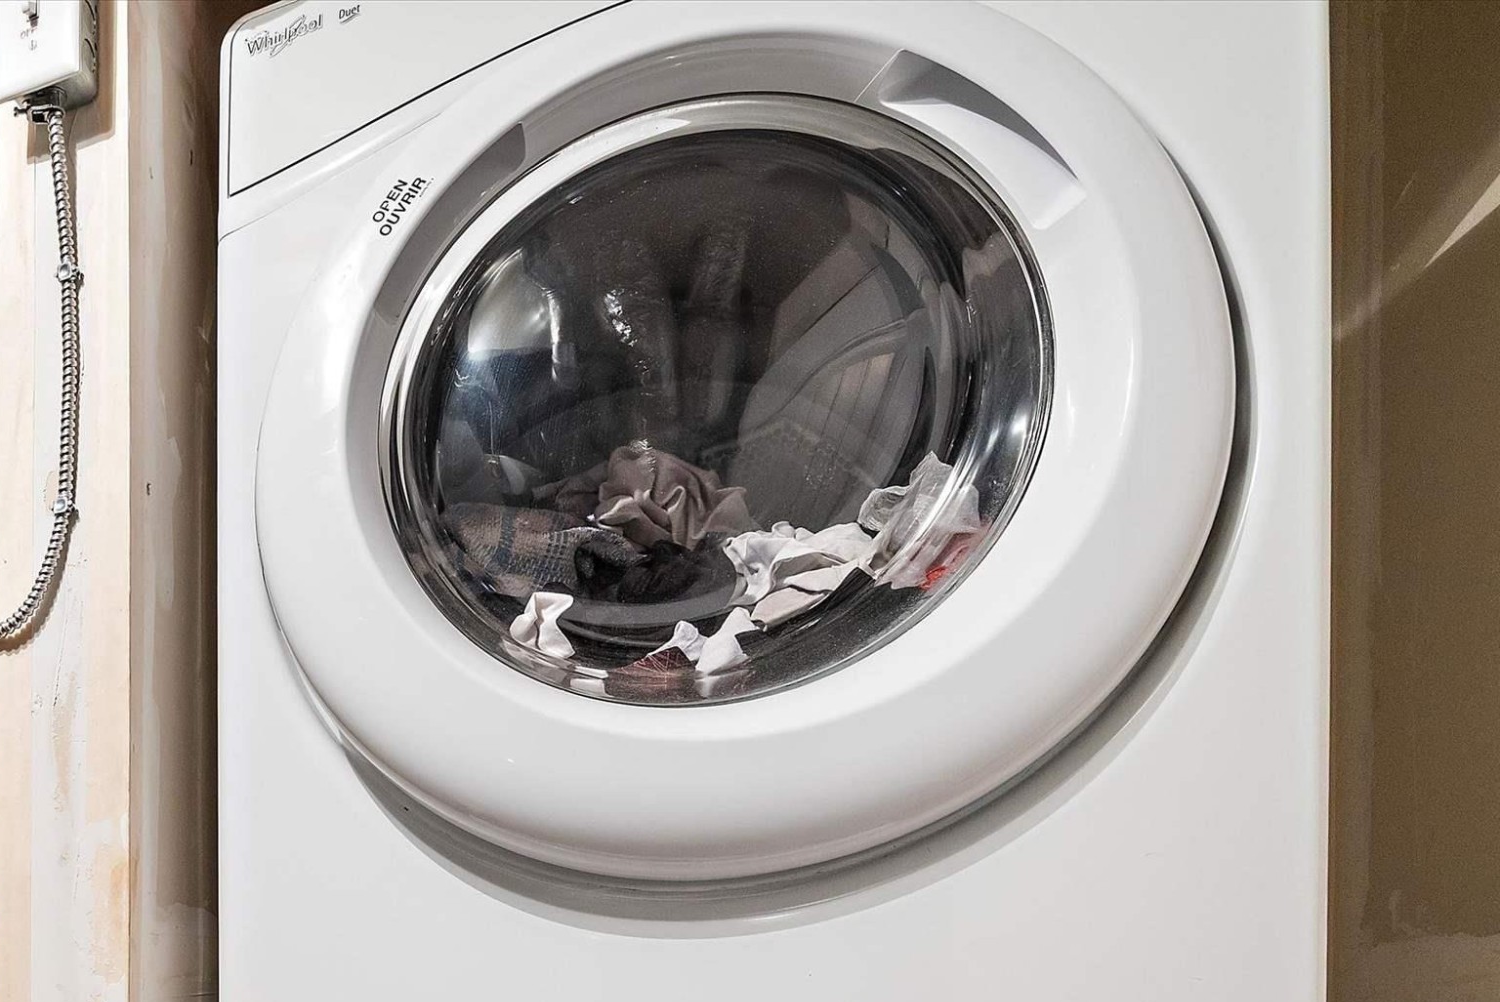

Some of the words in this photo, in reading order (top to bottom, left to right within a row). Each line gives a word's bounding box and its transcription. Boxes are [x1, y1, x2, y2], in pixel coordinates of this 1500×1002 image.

[338, 4, 361, 20] Duet
[246, 14, 323, 57] Whirlpool
[372, 179, 408, 223] OPEN
[379, 177, 427, 237] OUVRIR
